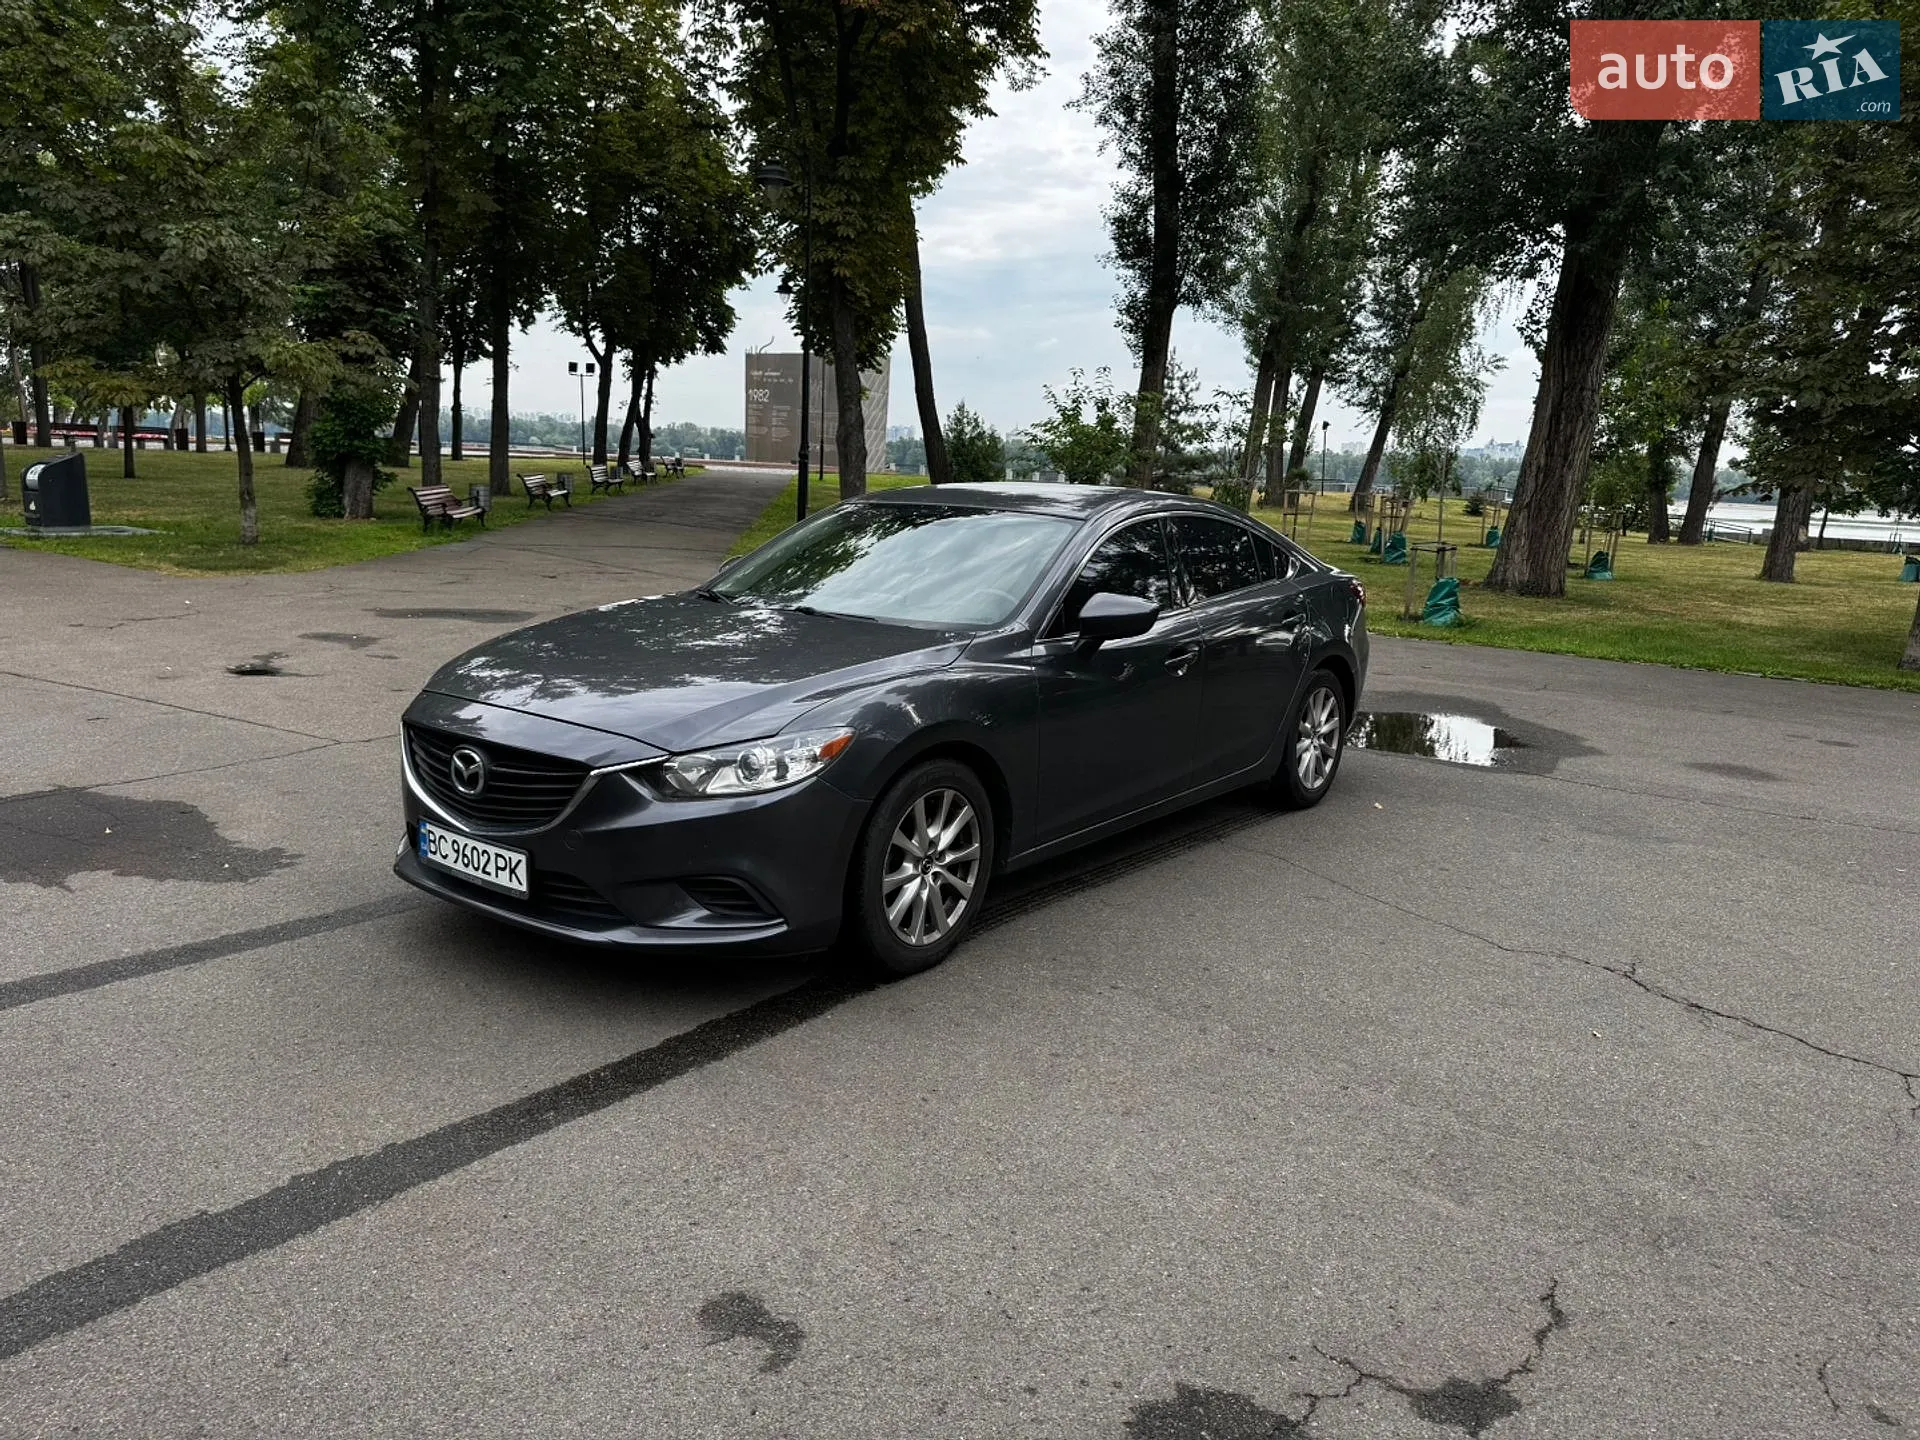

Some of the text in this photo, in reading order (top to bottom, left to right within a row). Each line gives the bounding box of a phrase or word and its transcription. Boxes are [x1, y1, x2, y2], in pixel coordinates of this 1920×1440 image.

[748, 389, 769, 402] 1982
[428, 829, 523, 886] BC 9602 PK
